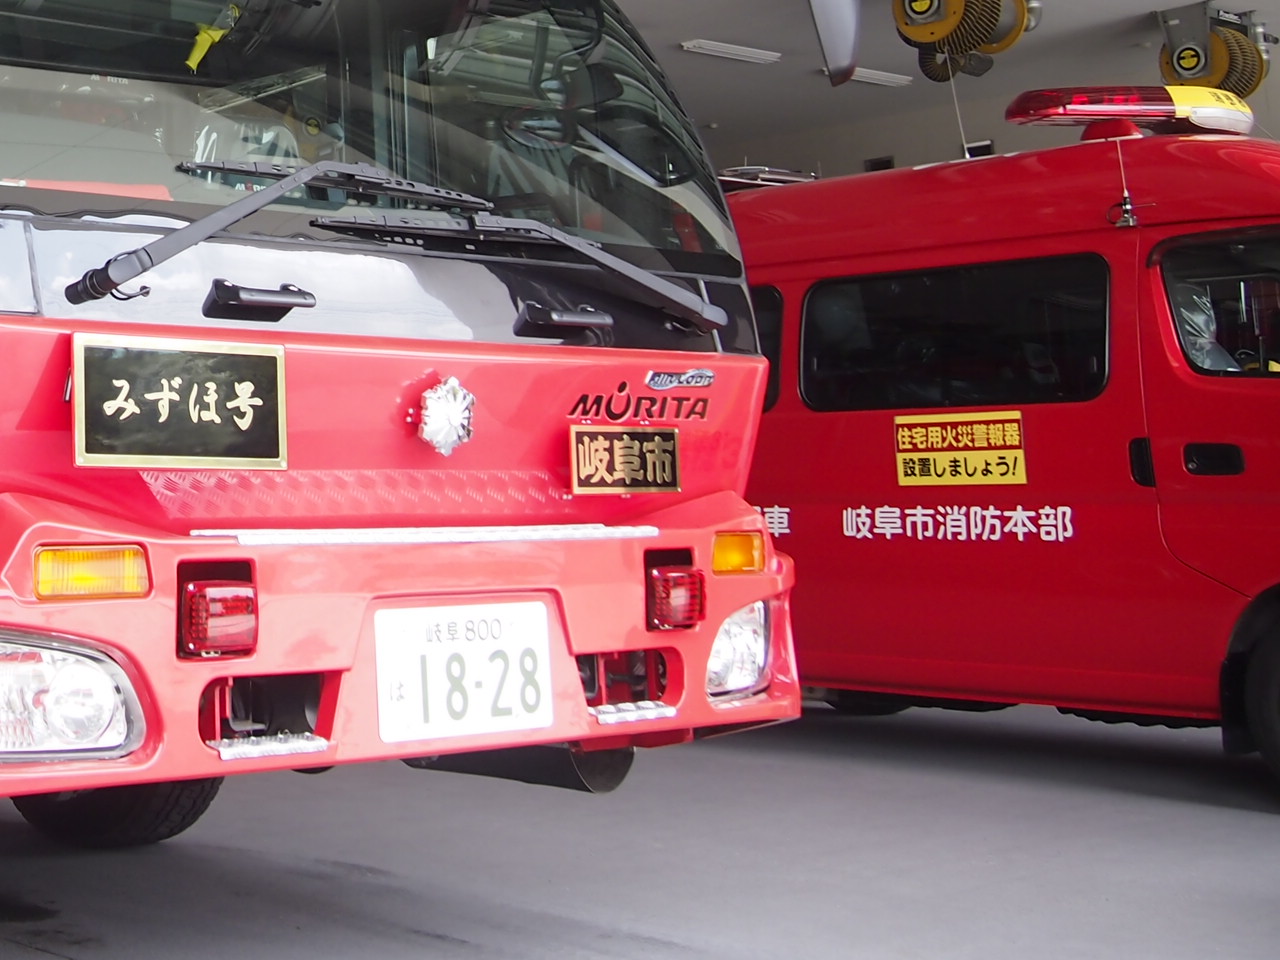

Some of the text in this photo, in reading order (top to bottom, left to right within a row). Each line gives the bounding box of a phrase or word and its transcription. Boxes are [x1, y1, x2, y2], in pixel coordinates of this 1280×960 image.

[102, 376, 264, 431] みずほ号
[567, 381, 709, 421] MORITA
[897, 422, 1021, 450] 住宅用火災警報器
[578, 434, 674, 485] 岐阜市
[752, 505, 791, 538] 車
[842, 504, 1074, 542] 岐阜市消防本部
[419, 647, 541, 724] 18-28
